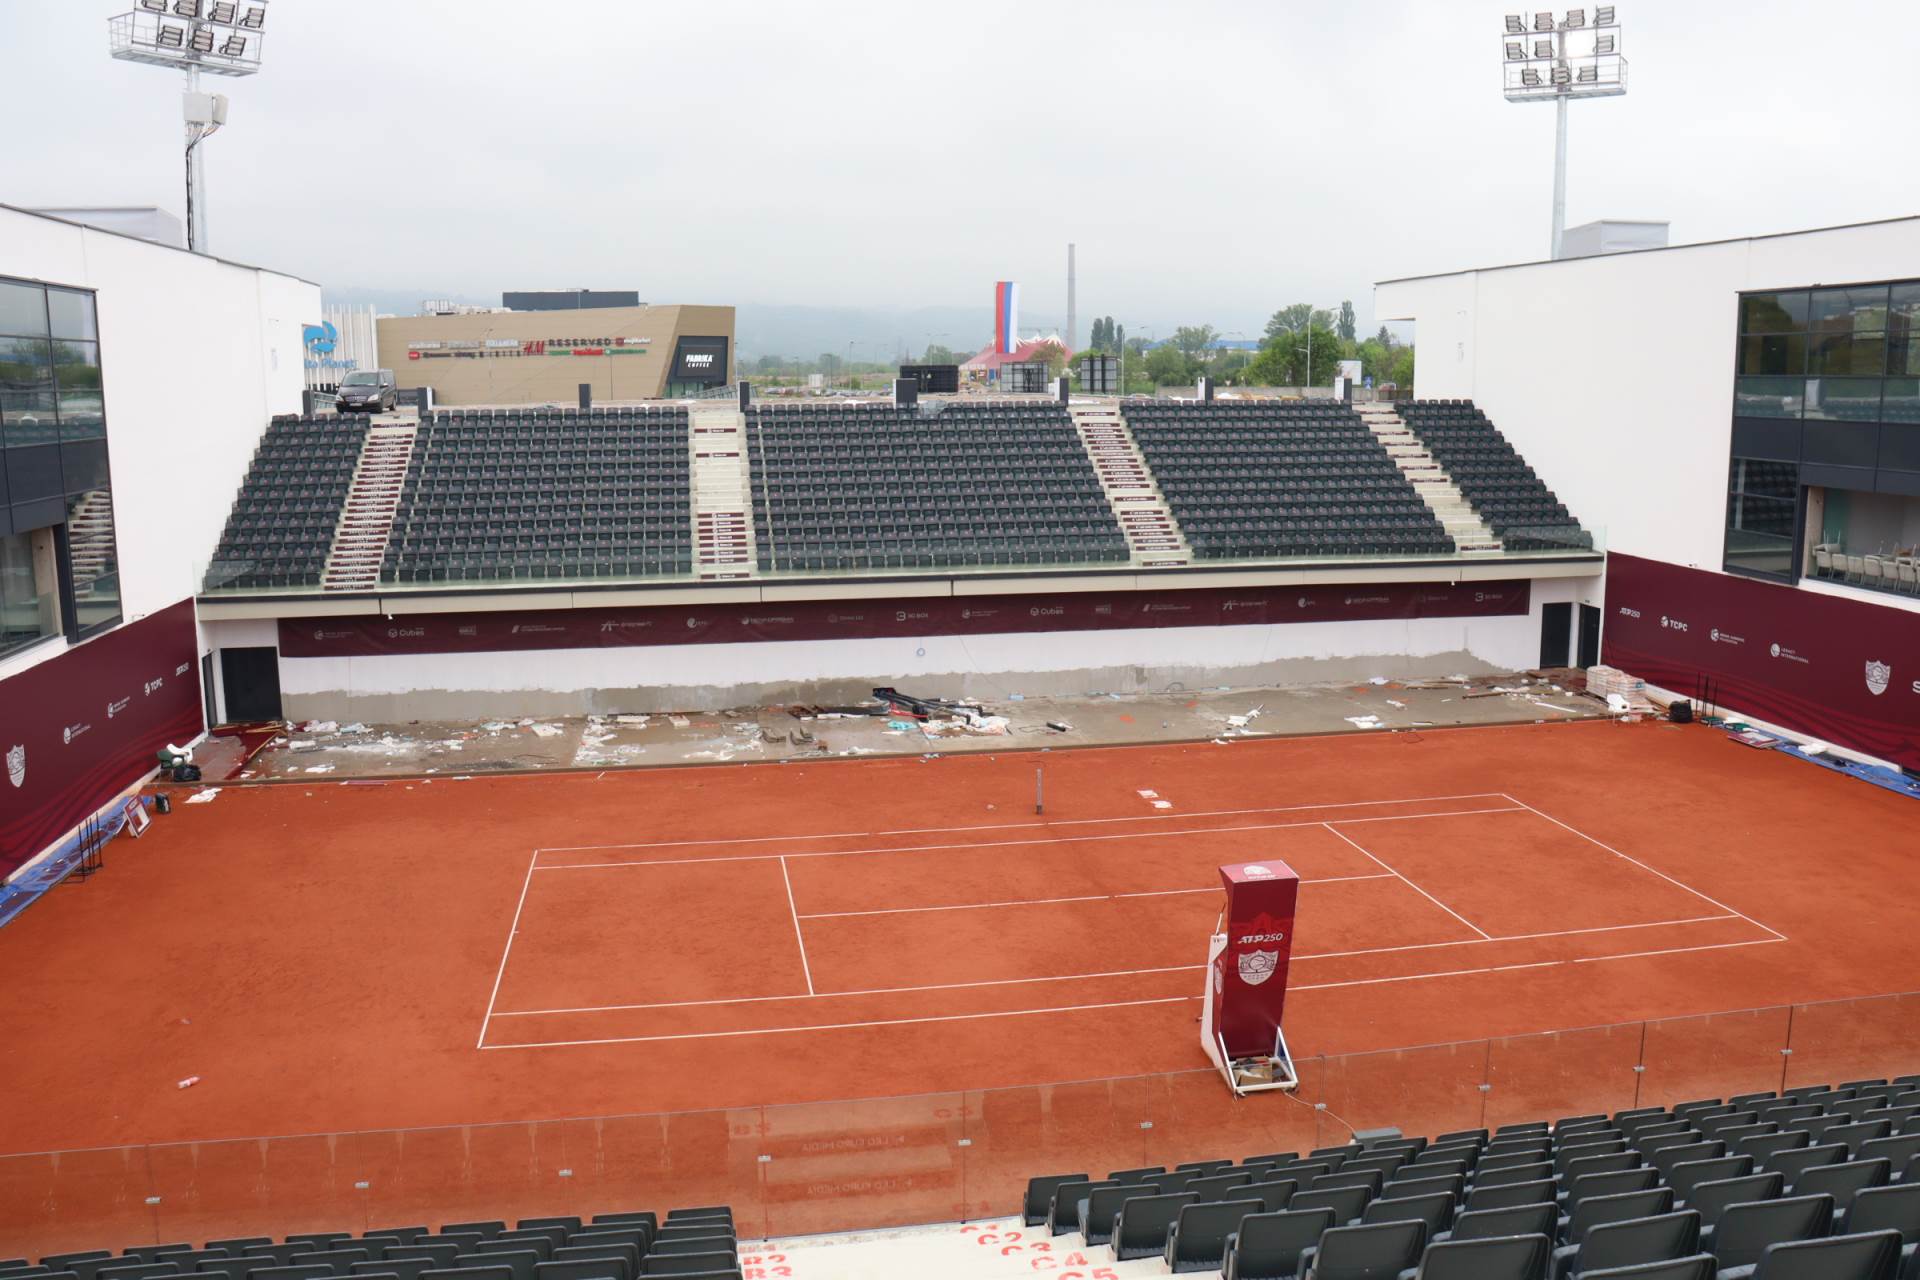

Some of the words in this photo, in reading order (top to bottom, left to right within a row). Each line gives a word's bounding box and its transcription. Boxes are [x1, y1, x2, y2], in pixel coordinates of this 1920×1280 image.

[548, 337, 612, 347] RESERVED
[322, 357, 357, 370] Planet
[686, 354, 713, 363] FABRIKA
[1040, 607, 1064, 616] Cubes
[1669, 619, 1688, 632] TCPC
[399, 628, 425, 638] Cubes
[150, 677, 163, 690] TCPC
[1237, 932, 1284, 944] ATP250
